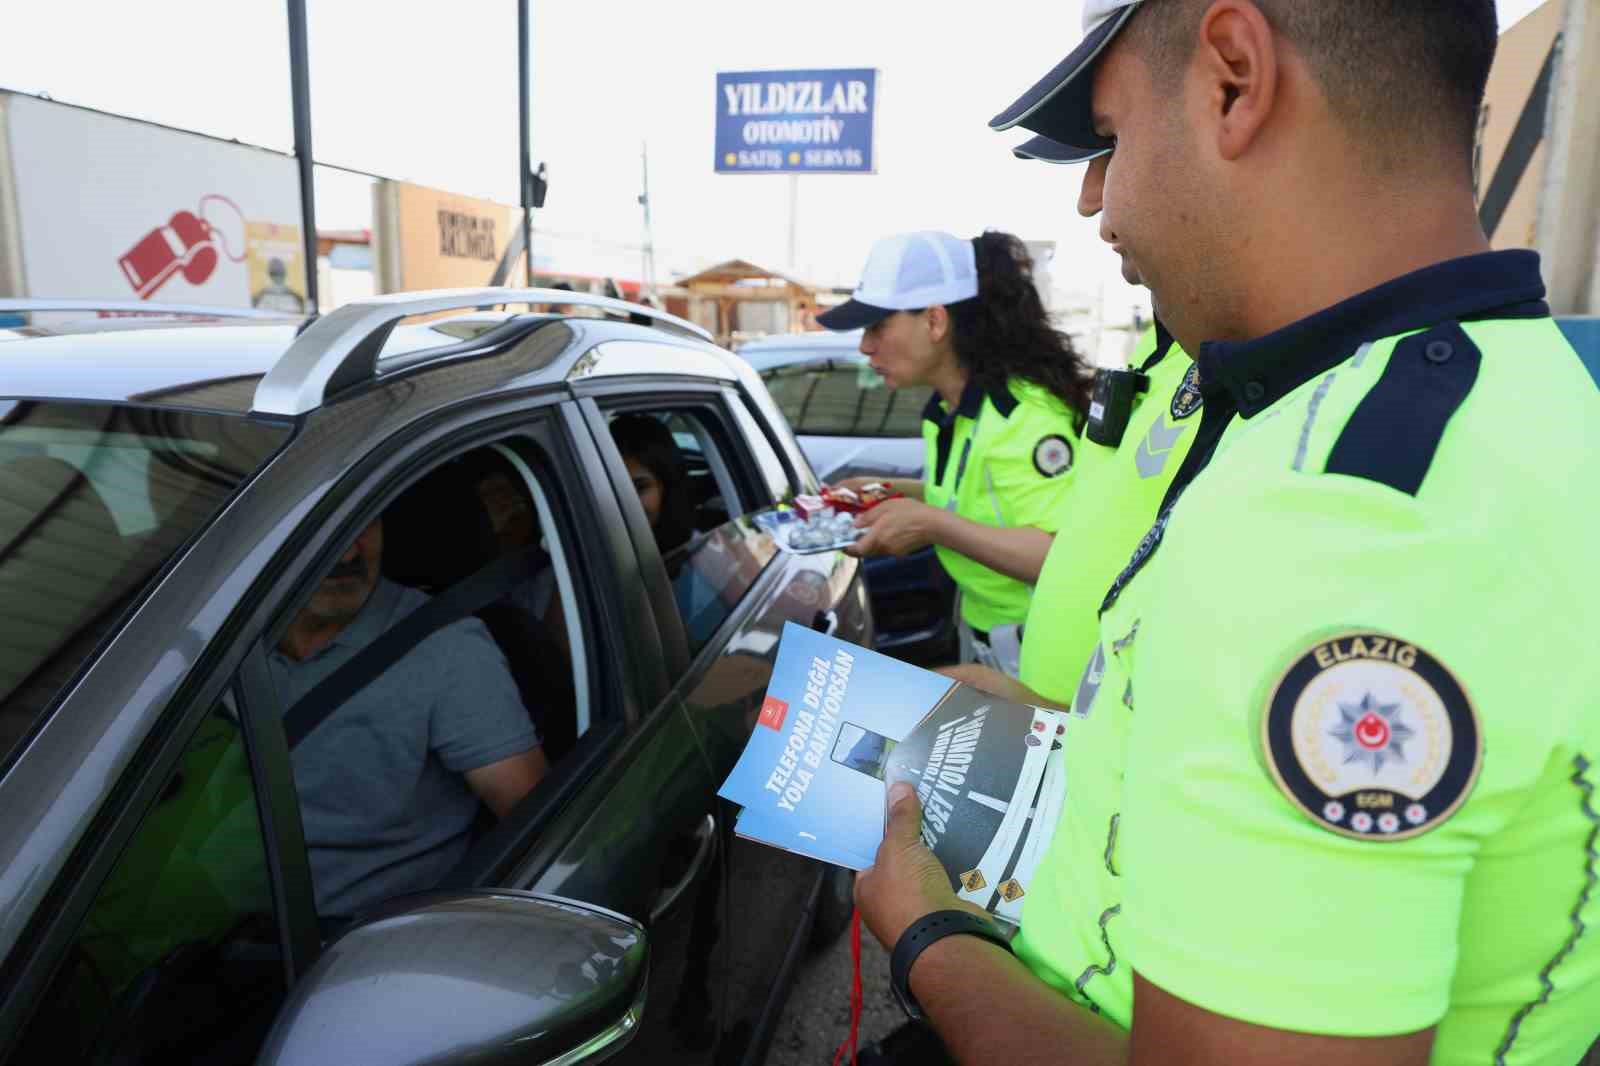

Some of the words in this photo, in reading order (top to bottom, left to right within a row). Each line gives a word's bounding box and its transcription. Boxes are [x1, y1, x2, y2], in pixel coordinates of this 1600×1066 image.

[724, 81, 867, 116] YILDIZLAR
[743, 115, 844, 145] OTOMOTİV
[766, 709, 815, 794] TELEFONA
[777, 768, 815, 812] YOLA
[804, 649, 854, 768] BAKIYORSAN
